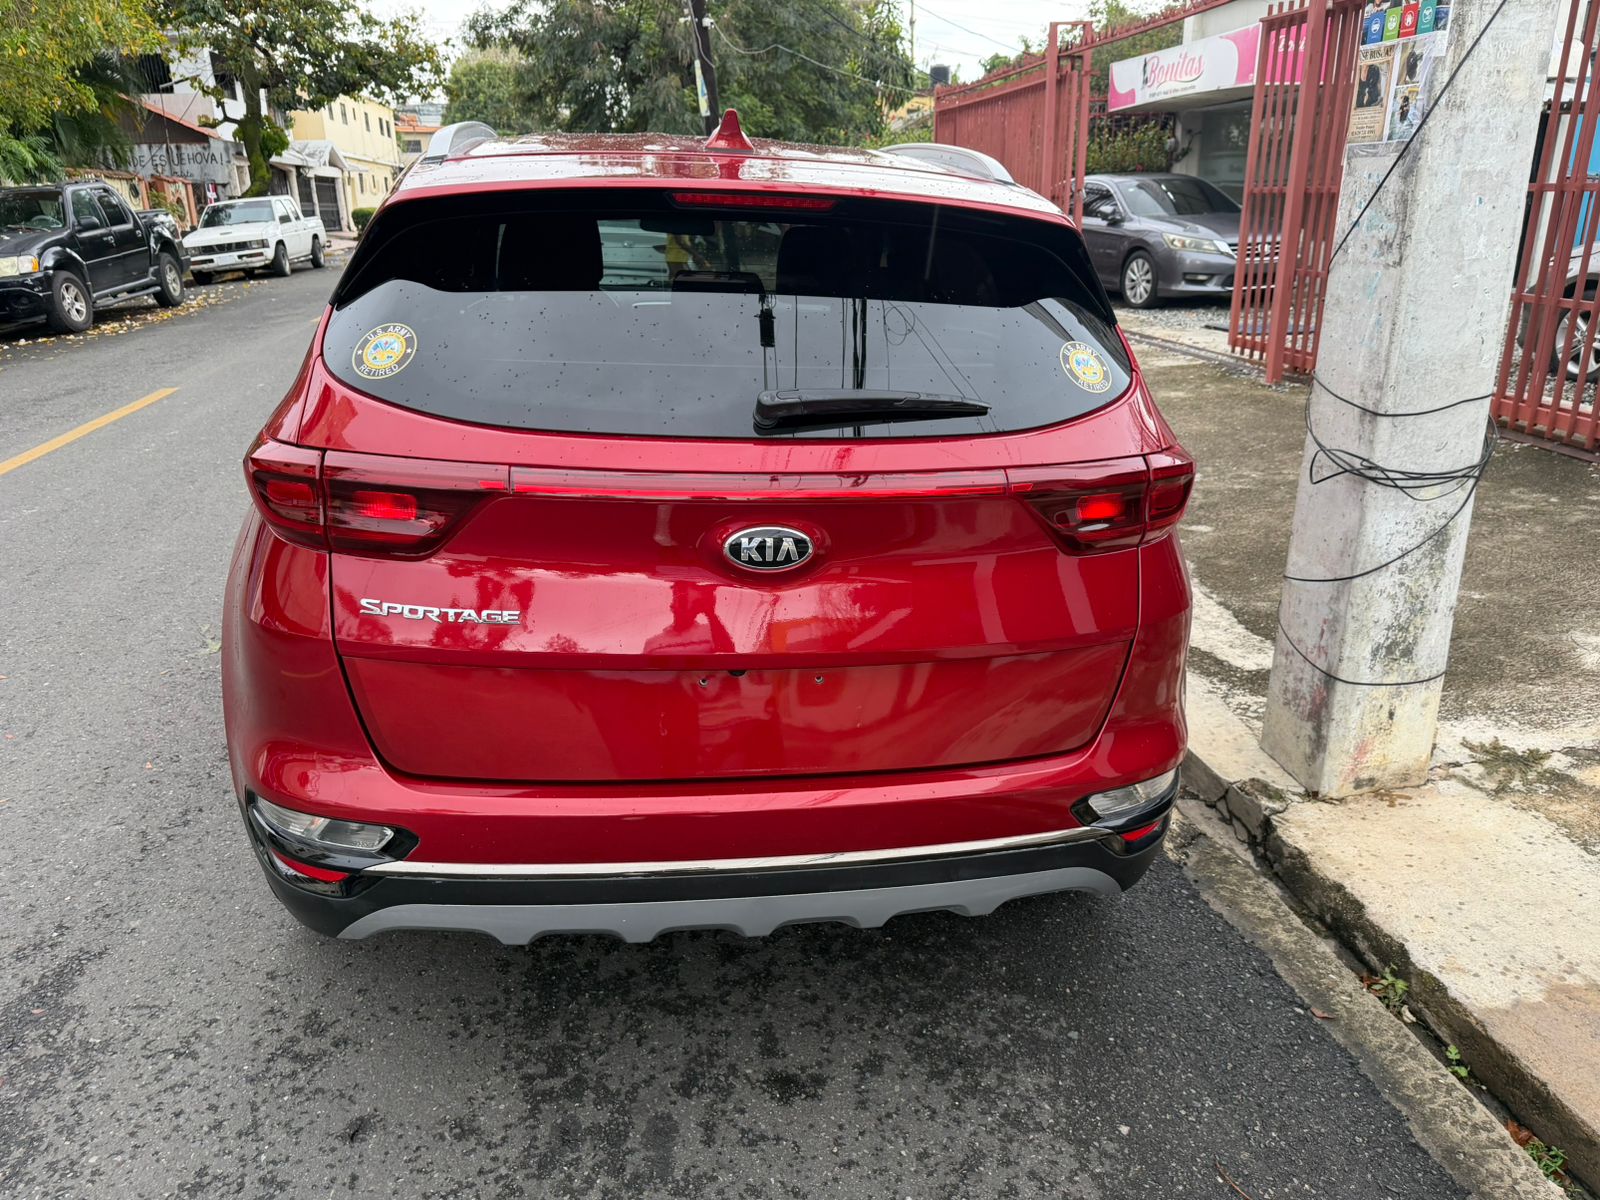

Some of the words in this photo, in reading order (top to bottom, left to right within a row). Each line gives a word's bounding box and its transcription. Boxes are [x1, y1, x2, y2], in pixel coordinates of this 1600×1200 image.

[1147, 51, 1205, 88] Bonitas
[386, 325, 412, 339] ARMY
[359, 363, 399, 377] RETIRED
[740, 537, 799, 562] KIA
[359, 598, 521, 625] SPORTAGE
